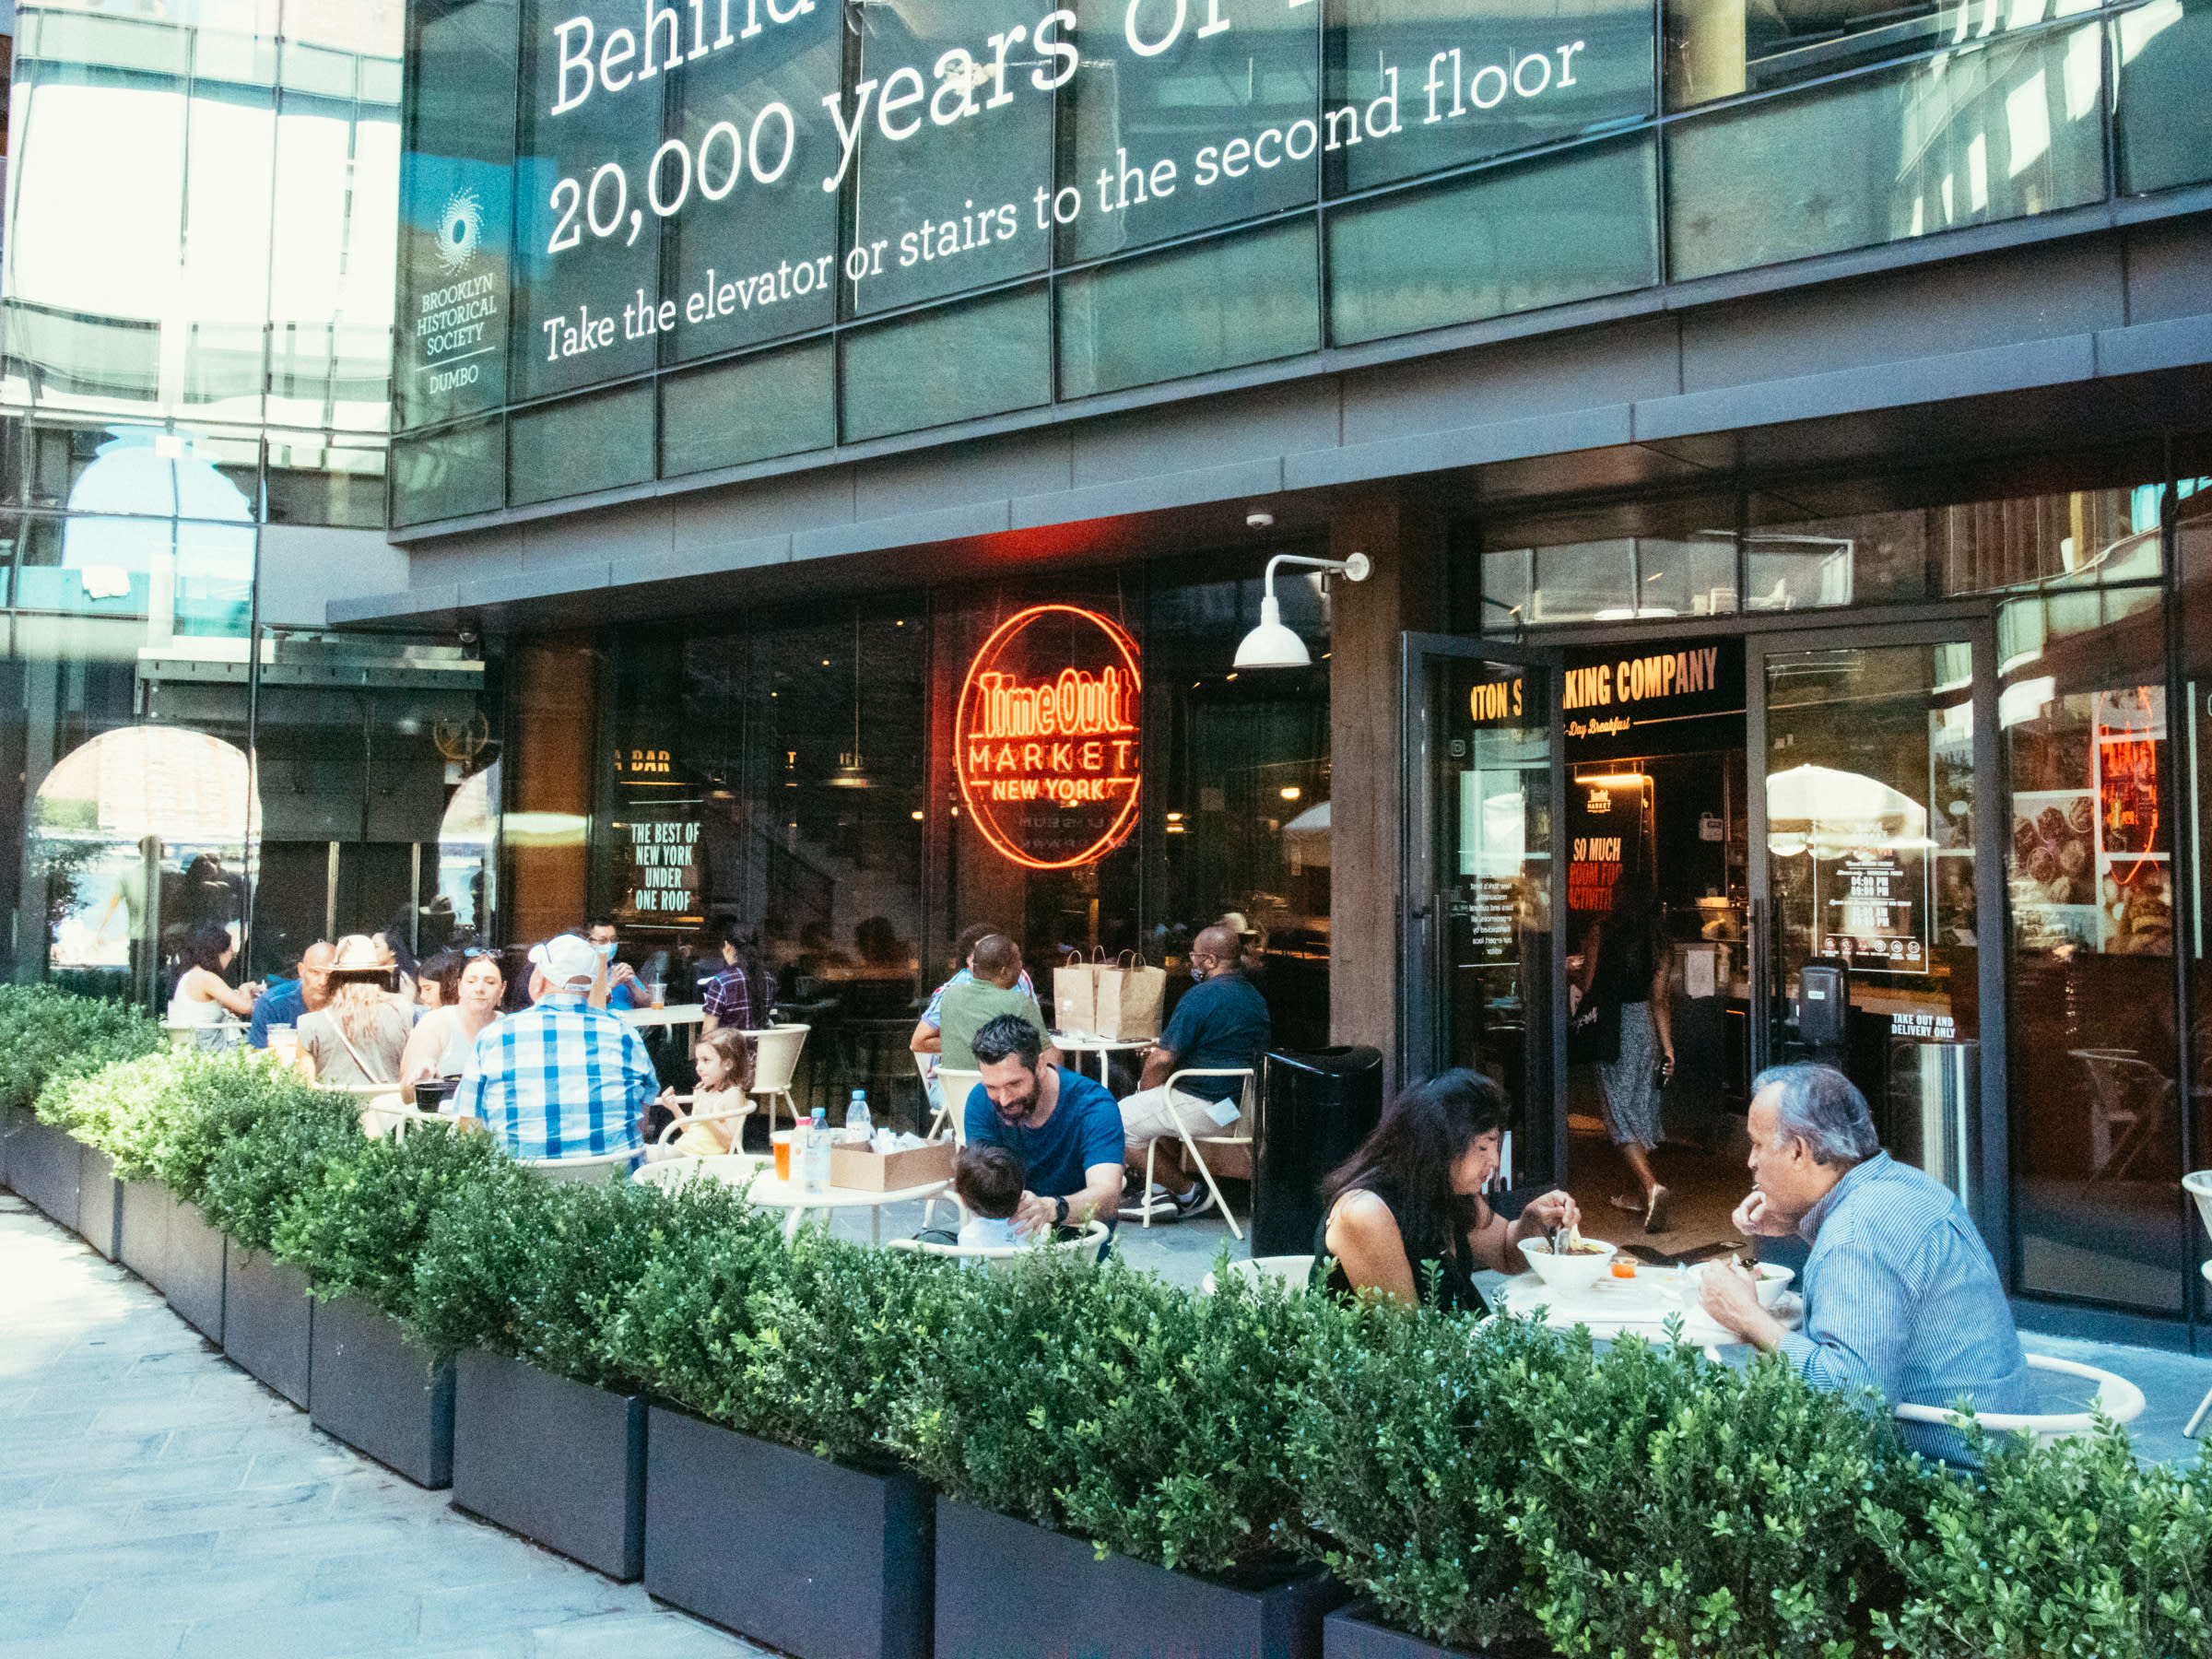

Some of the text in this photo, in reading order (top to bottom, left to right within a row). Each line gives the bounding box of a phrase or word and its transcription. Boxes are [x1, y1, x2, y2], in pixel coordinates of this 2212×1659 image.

[551, 0, 815, 116] Behin
[547, 101, 794, 253] 20,000
[821, 8, 1078, 193] years
[543, 41, 1585, 361] Take the elevator or stairs to the second floor
[422, 273, 494, 313] BROOKLYN
[417, 295, 498, 336] HISTORICAL
[427, 322, 485, 356] SOCIETY
[429, 364, 478, 394] DUMBO
[1563, 664, 1611, 710] KING
[1617, 647, 1718, 703] COMPANY
[1588, 715, 1630, 736] Breakfast
[631, 750, 670, 772] BAR
[969, 740, 1133, 772] MARKET
[993, 778, 1106, 800] NEW YORK
[631, 822, 700, 843] THE BEST OF
[636, 845, 692, 865] NEW YORK
[1573, 837, 1621, 862] SO MUCH
[644, 867, 682, 888] UNDER
[1851, 877, 1888, 887] 04:00 PM
[635, 889, 691, 912] ONE ROOF
[1877, 887, 1888, 897] PM
[1891, 1024, 1956, 1039] DELIVERY ONLY
[1892, 1013, 1954, 1028] TAKE OUT AND
